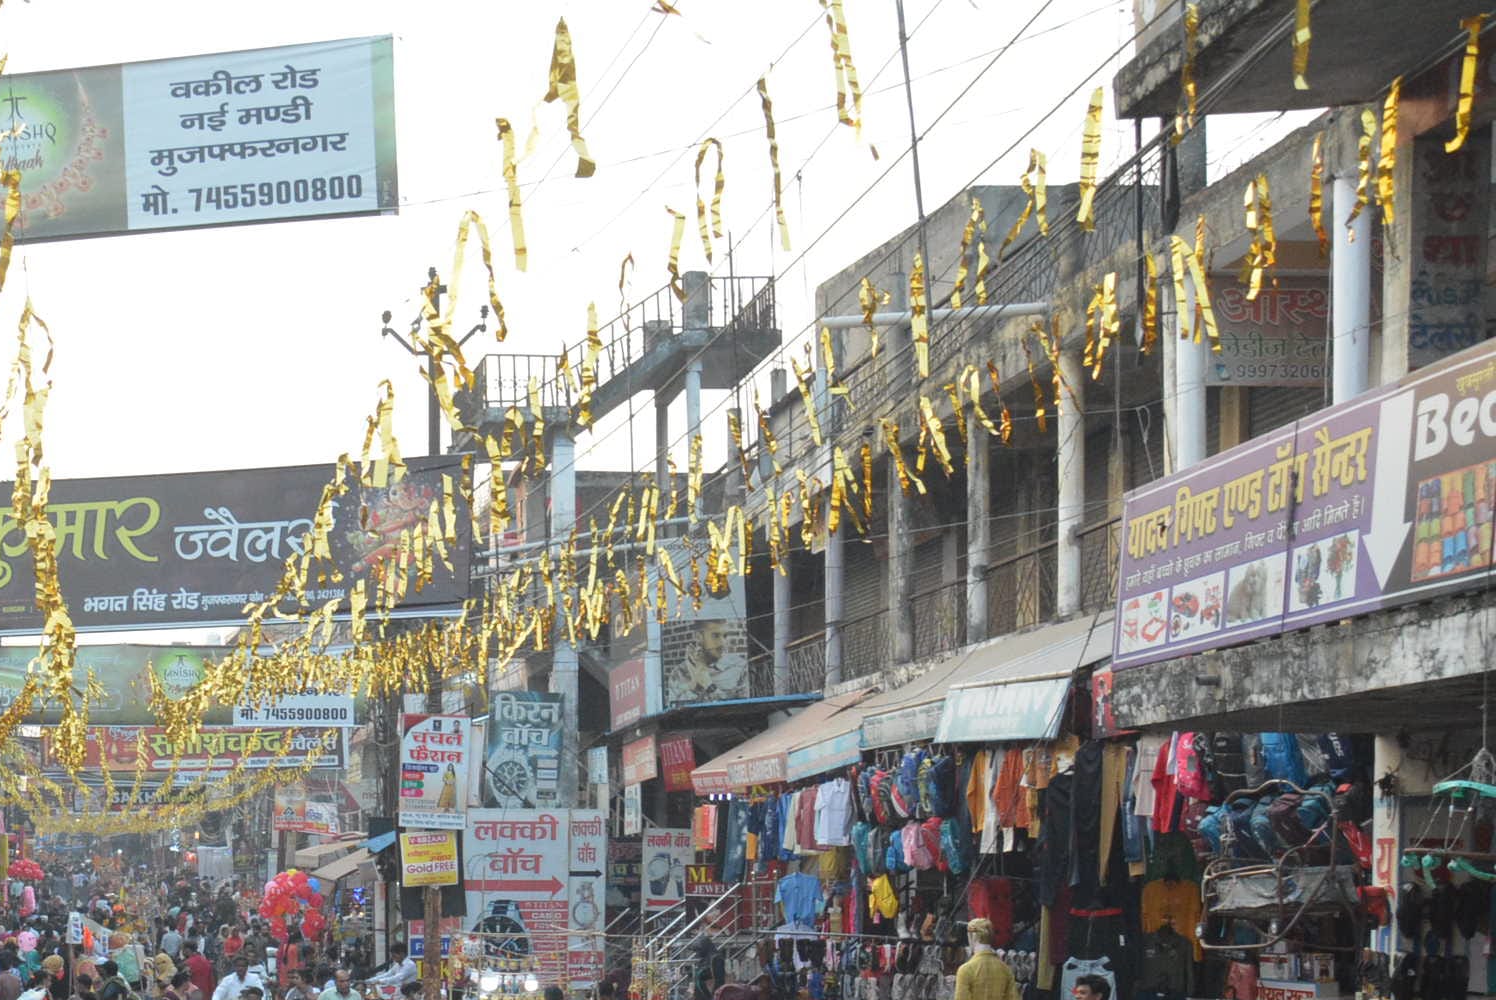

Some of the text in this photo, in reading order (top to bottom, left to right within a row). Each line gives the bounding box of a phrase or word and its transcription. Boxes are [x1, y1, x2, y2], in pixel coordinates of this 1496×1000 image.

[169, 63, 321, 100] वकील रोड
[179, 94, 312, 133] नई मण्डी
[149, 131, 349, 177] मुजफ्फरनगर
[140, 173, 364, 217] मो. 7455900800
[1126, 505, 1173, 561] यादव
[1172, 485, 1221, 547] गिफ्ट
[1223, 469, 1264, 531] एण्ड
[83, 594, 129, 613] भगत
[131, 587, 166, 612] सिंह
[170, 587, 202, 610] रोड
[263, 707, 348, 721] 7455900800
[411, 729, 464, 746] चंचल
[408, 745, 464, 764] फैशन
[473, 814, 560, 842] लक्की
[570, 816, 603, 838] लक्की
[647, 832, 672, 849] लक्की
[673, 832, 691, 849] वॉच
[488, 847, 543, 876] वॉच
[577, 843, 597, 865] वॉच
[406, 859, 456, 875] Gold FREE
[687, 867, 713, 884] M.
